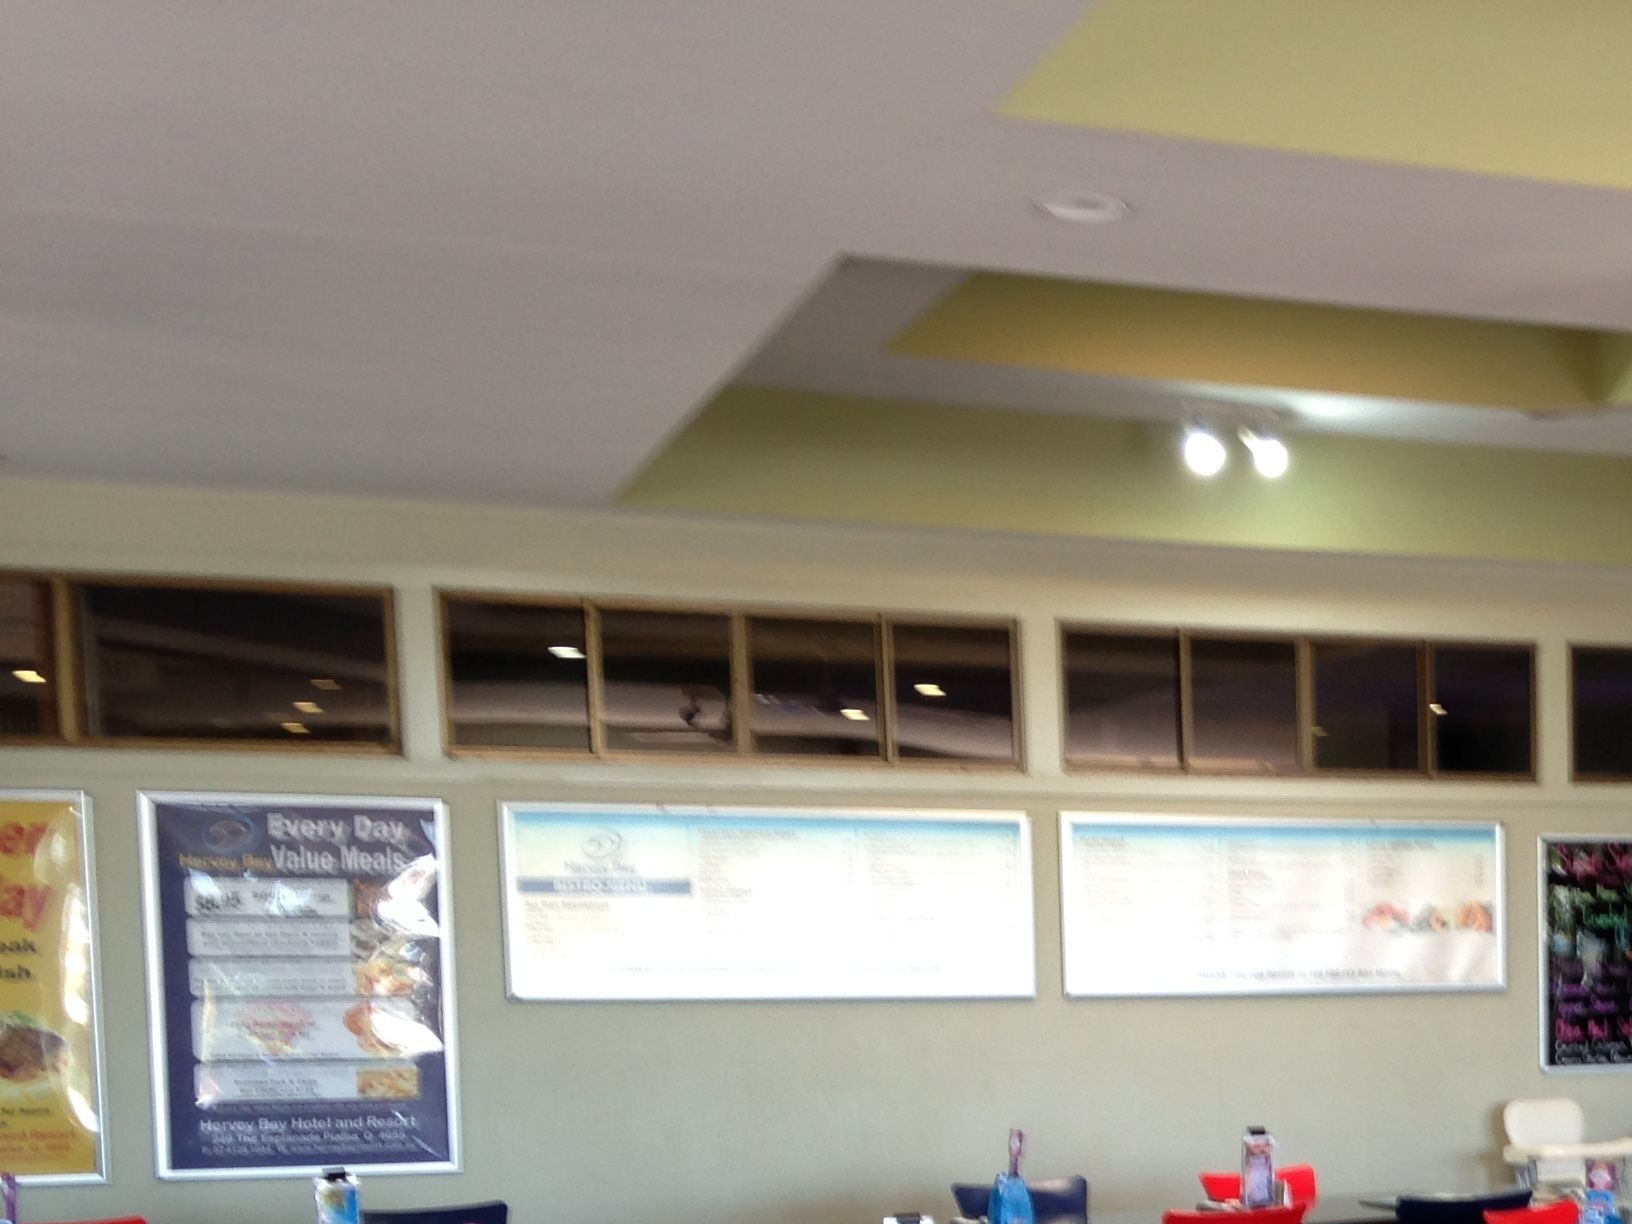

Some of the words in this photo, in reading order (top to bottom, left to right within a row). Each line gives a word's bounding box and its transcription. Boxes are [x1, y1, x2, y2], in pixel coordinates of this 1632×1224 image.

[267, 812, 345, 843] Every
[353, 814, 409, 845] Day
[179, 853, 239, 870] Hervey
[241, 855, 273, 873] Bay
[270, 845, 336, 873] Value
[340, 847, 405, 874] Meals
[199, 1117, 255, 1133] Hervey
[258, 1116, 288, 1131] Bay
[291, 1114, 332, 1130] Hotel
[336, 1114, 363, 1128] and
[366, 1113, 417, 1128] Resort
